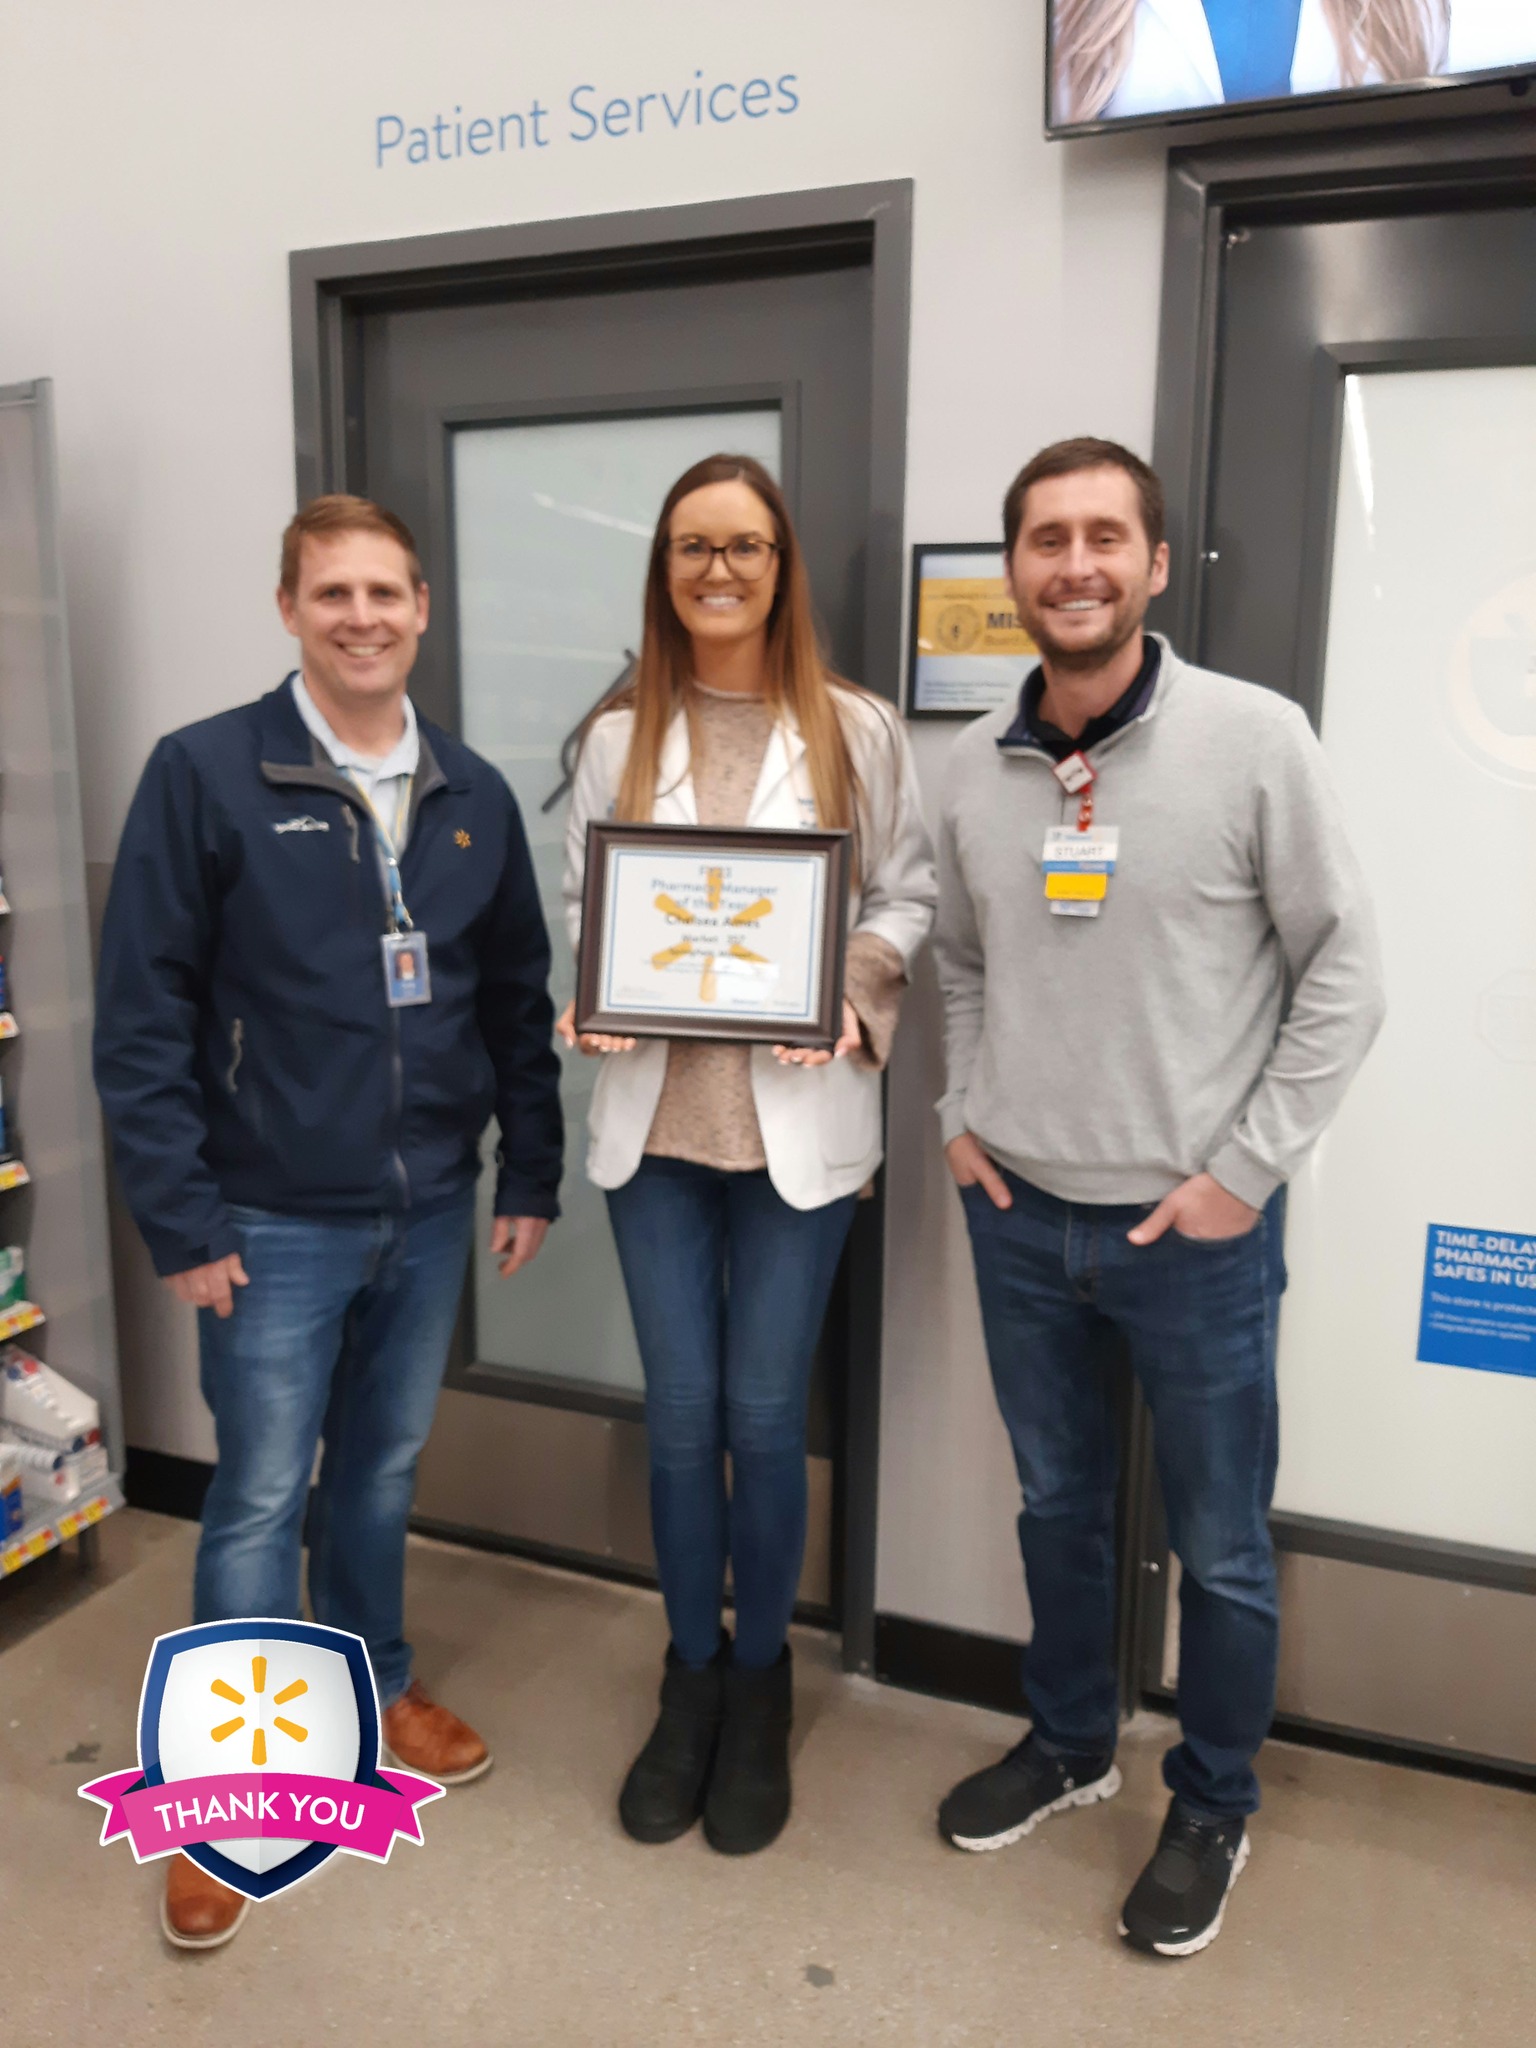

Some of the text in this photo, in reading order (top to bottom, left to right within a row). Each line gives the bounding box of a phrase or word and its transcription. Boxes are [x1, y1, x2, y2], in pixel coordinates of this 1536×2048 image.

[375, 69, 800, 168] Patient Services
[1054, 846, 1105, 858] STUART
[651, 879, 778, 899] Pharmacy Manager
[1434, 1246, 1536, 1273] PHARMACY
[1432, 1262, 1487, 1284] SAFES
[1491, 1268, 1511, 1286] IN
[1431, 1290, 1452, 1305] This
[1453, 1296, 1481, 1309] store
